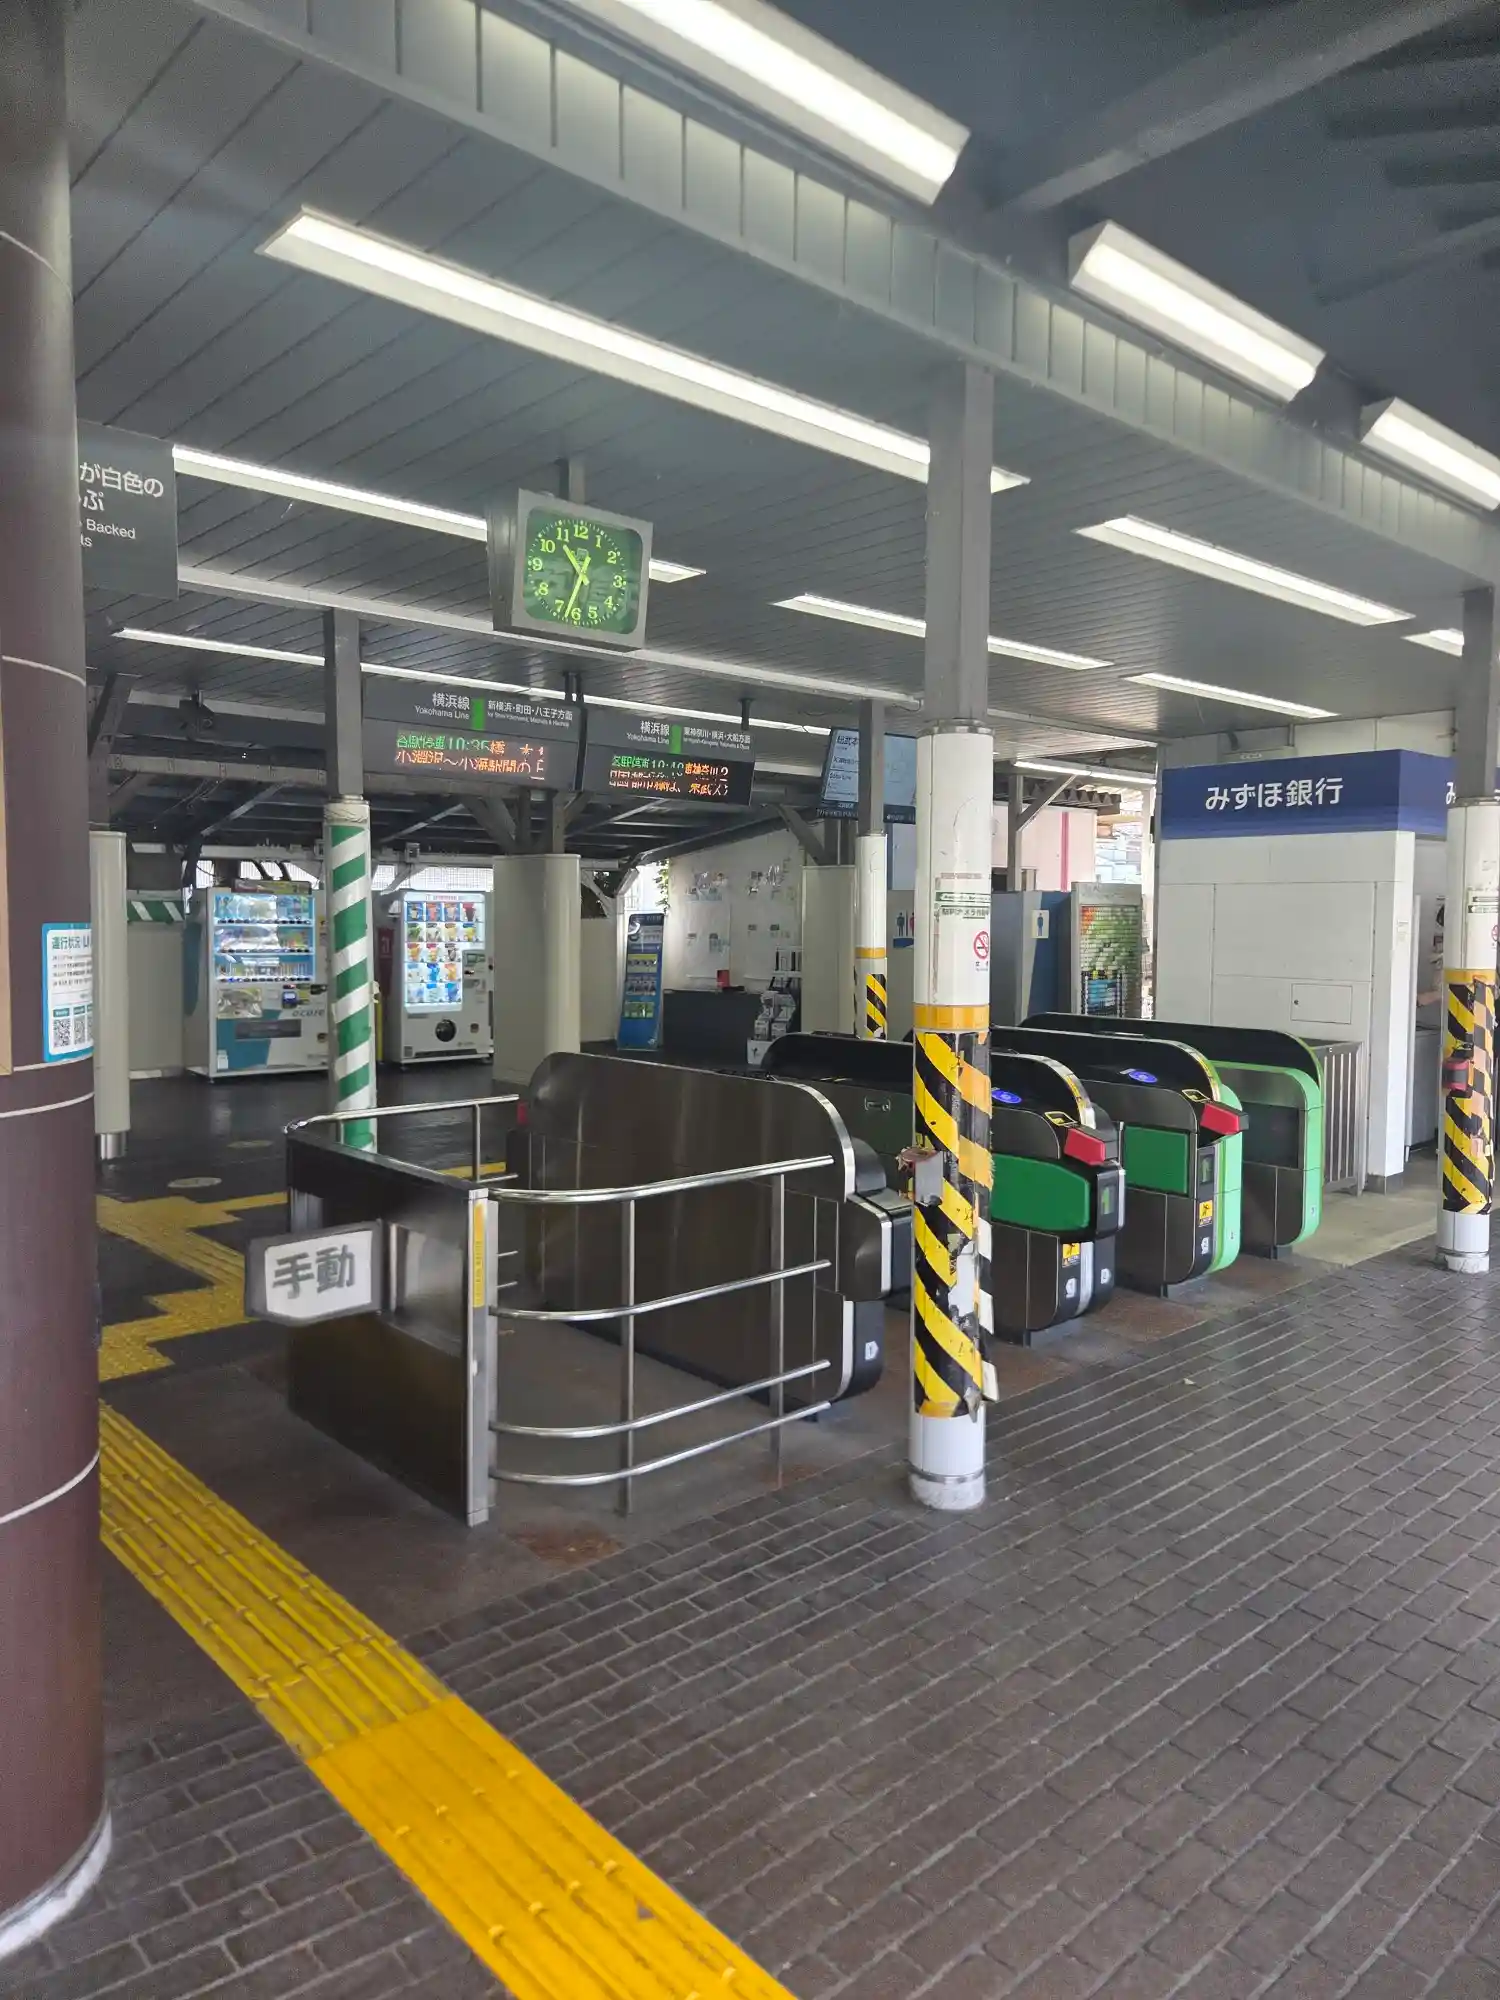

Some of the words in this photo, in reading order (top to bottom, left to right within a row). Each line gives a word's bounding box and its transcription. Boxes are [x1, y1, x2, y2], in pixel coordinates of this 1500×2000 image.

[80, 461, 164, 498] が白色の
[78, 489, 106, 513] ぷ
[86, 519, 136, 540] Backed
[556, 527, 570, 542] 11
[573, 524, 589, 540] 12
[540, 538, 556, 553] 10
[594, 535, 602, 548] 1
[532, 558, 543, 571] 9
[607, 551, 617, 564] 2
[612, 575, 624, 588] 3
[538, 583, 549, 596] 8
[554, 599, 565, 613] 7
[603, 595, 614, 608] 4
[570, 607, 582, 621] 6
[588, 606, 598, 619] 5
[432, 692, 470, 711] 横浜線
[414, 705, 453, 718] Yokohama
[454, 711, 470, 720] Line
[640, 720, 670, 737] 横浜線
[1205, 777, 1344, 811] みずほ銀行
[272, 1245, 356, 1300] 手動
